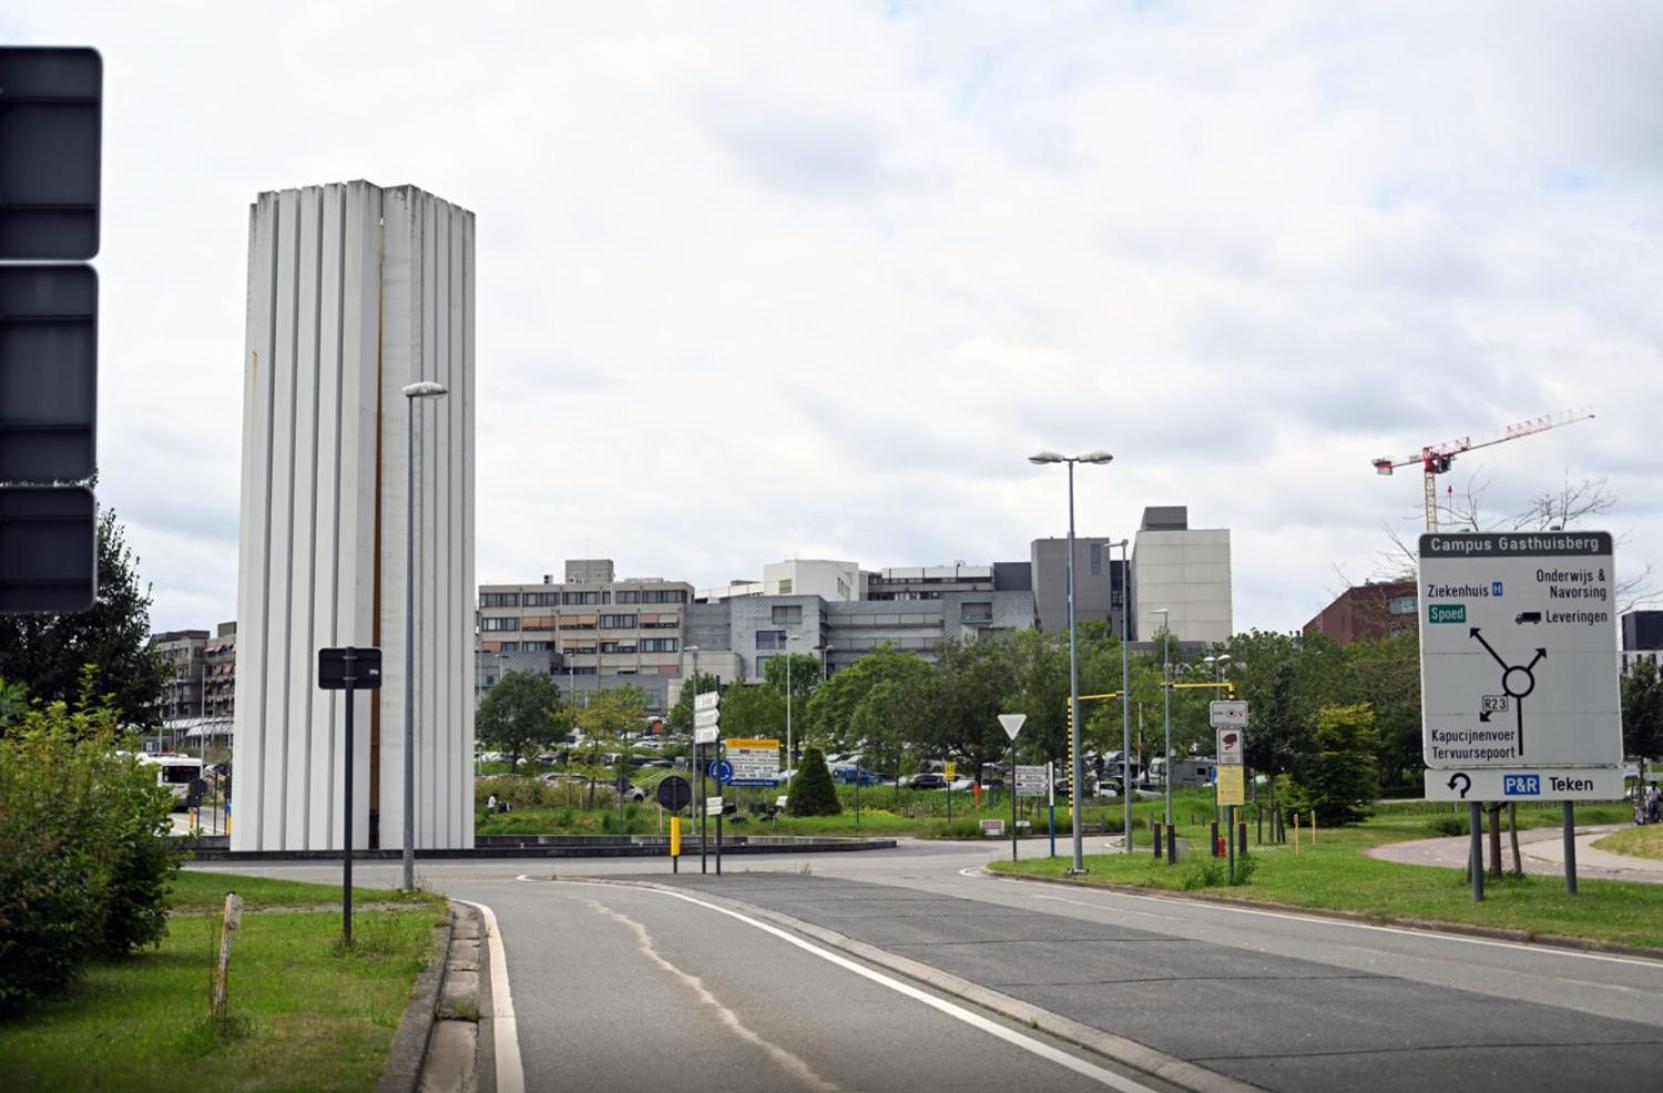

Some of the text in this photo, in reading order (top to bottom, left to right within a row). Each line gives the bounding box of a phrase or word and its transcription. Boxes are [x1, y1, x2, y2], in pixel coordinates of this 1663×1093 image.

[1431, 537, 1599, 553] Campus Gasthuisberg
[1536, 569, 1605, 585] Onderwijs &
[1428, 584, 1489, 597] Ziekenhuis
[1550, 586, 1607, 601] Navorsing
[1431, 607, 1464, 622] Spoed
[1546, 610, 1608, 625] Leveringen
[1485, 698, 1506, 710] R23
[1431, 729, 1515, 744] Kapucijnenvoer
[1432, 746, 1516, 761] Tervuursepoort
[1505, 776, 1594, 792] P&R Teken
